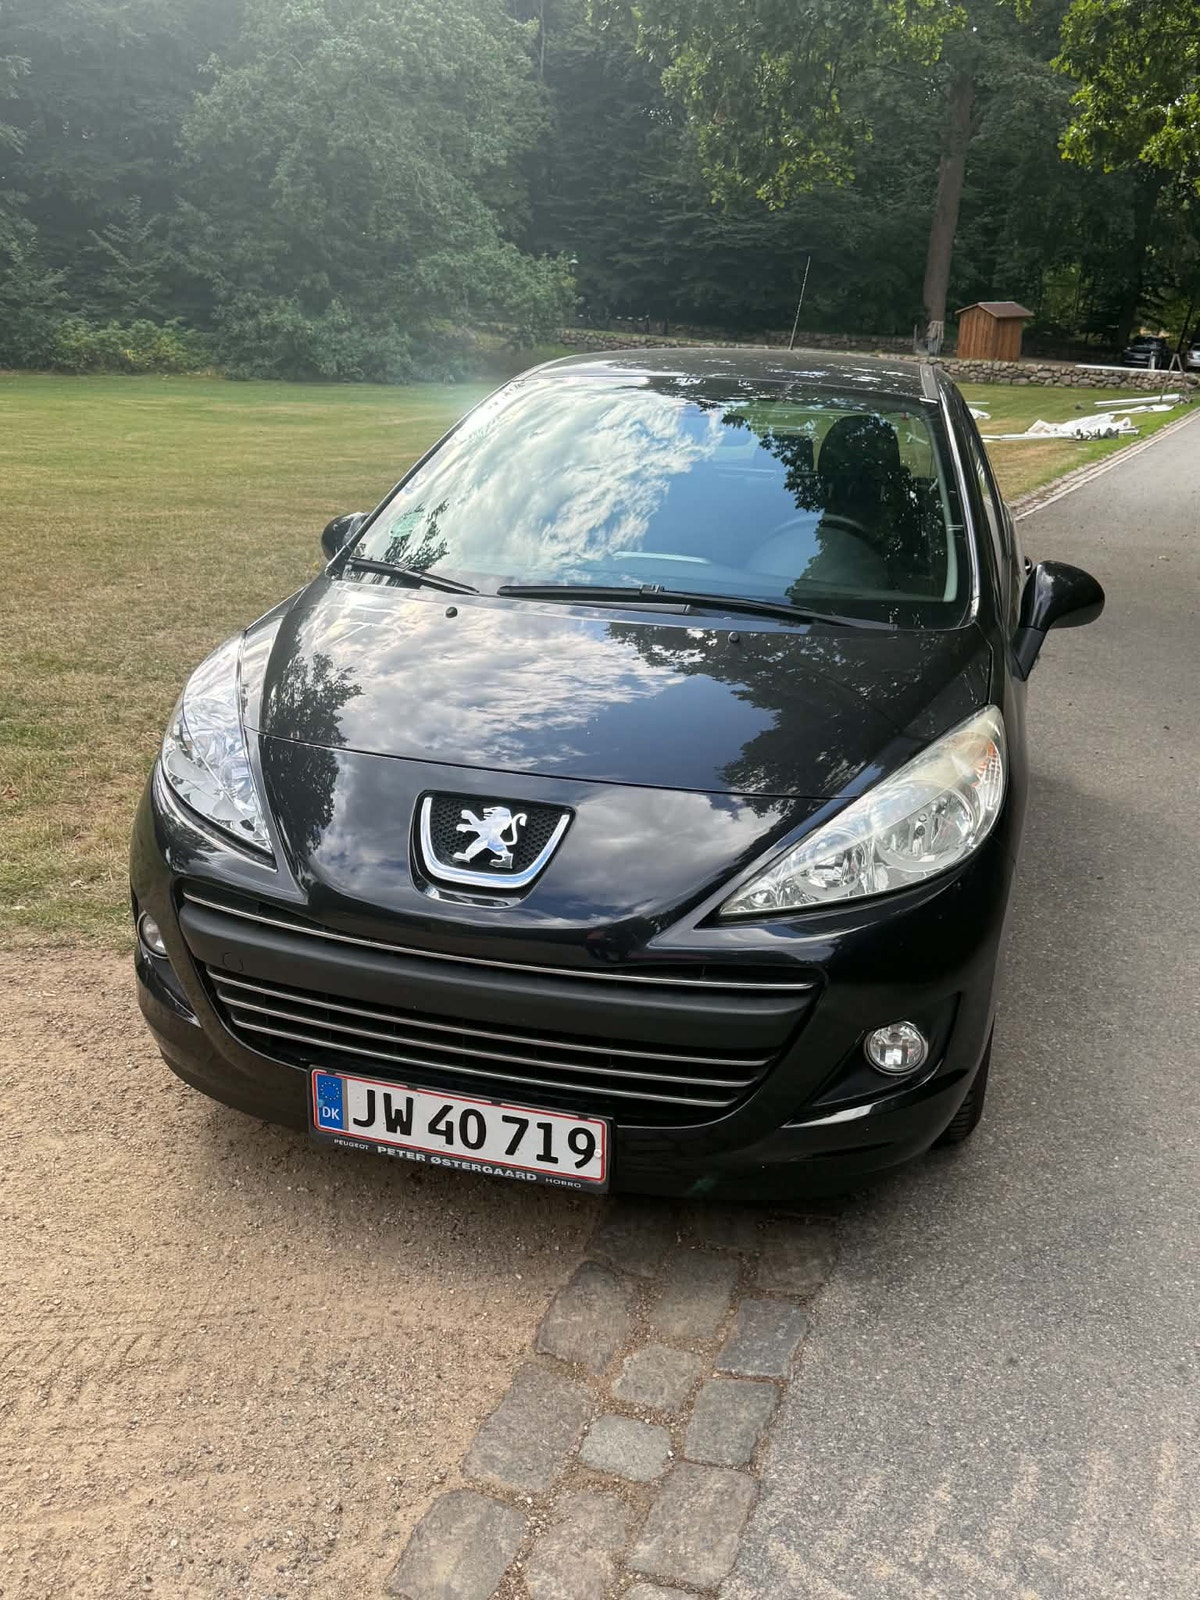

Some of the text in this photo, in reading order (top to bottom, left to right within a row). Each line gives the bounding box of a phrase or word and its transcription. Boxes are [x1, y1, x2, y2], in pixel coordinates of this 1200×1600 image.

[322, 1105, 340, 1121] DK
[352, 1089, 596, 1169] JW 40 719
[334, 1139, 582, 1189] PEUGEOT PETER ØSTERGAARD HOBRO
